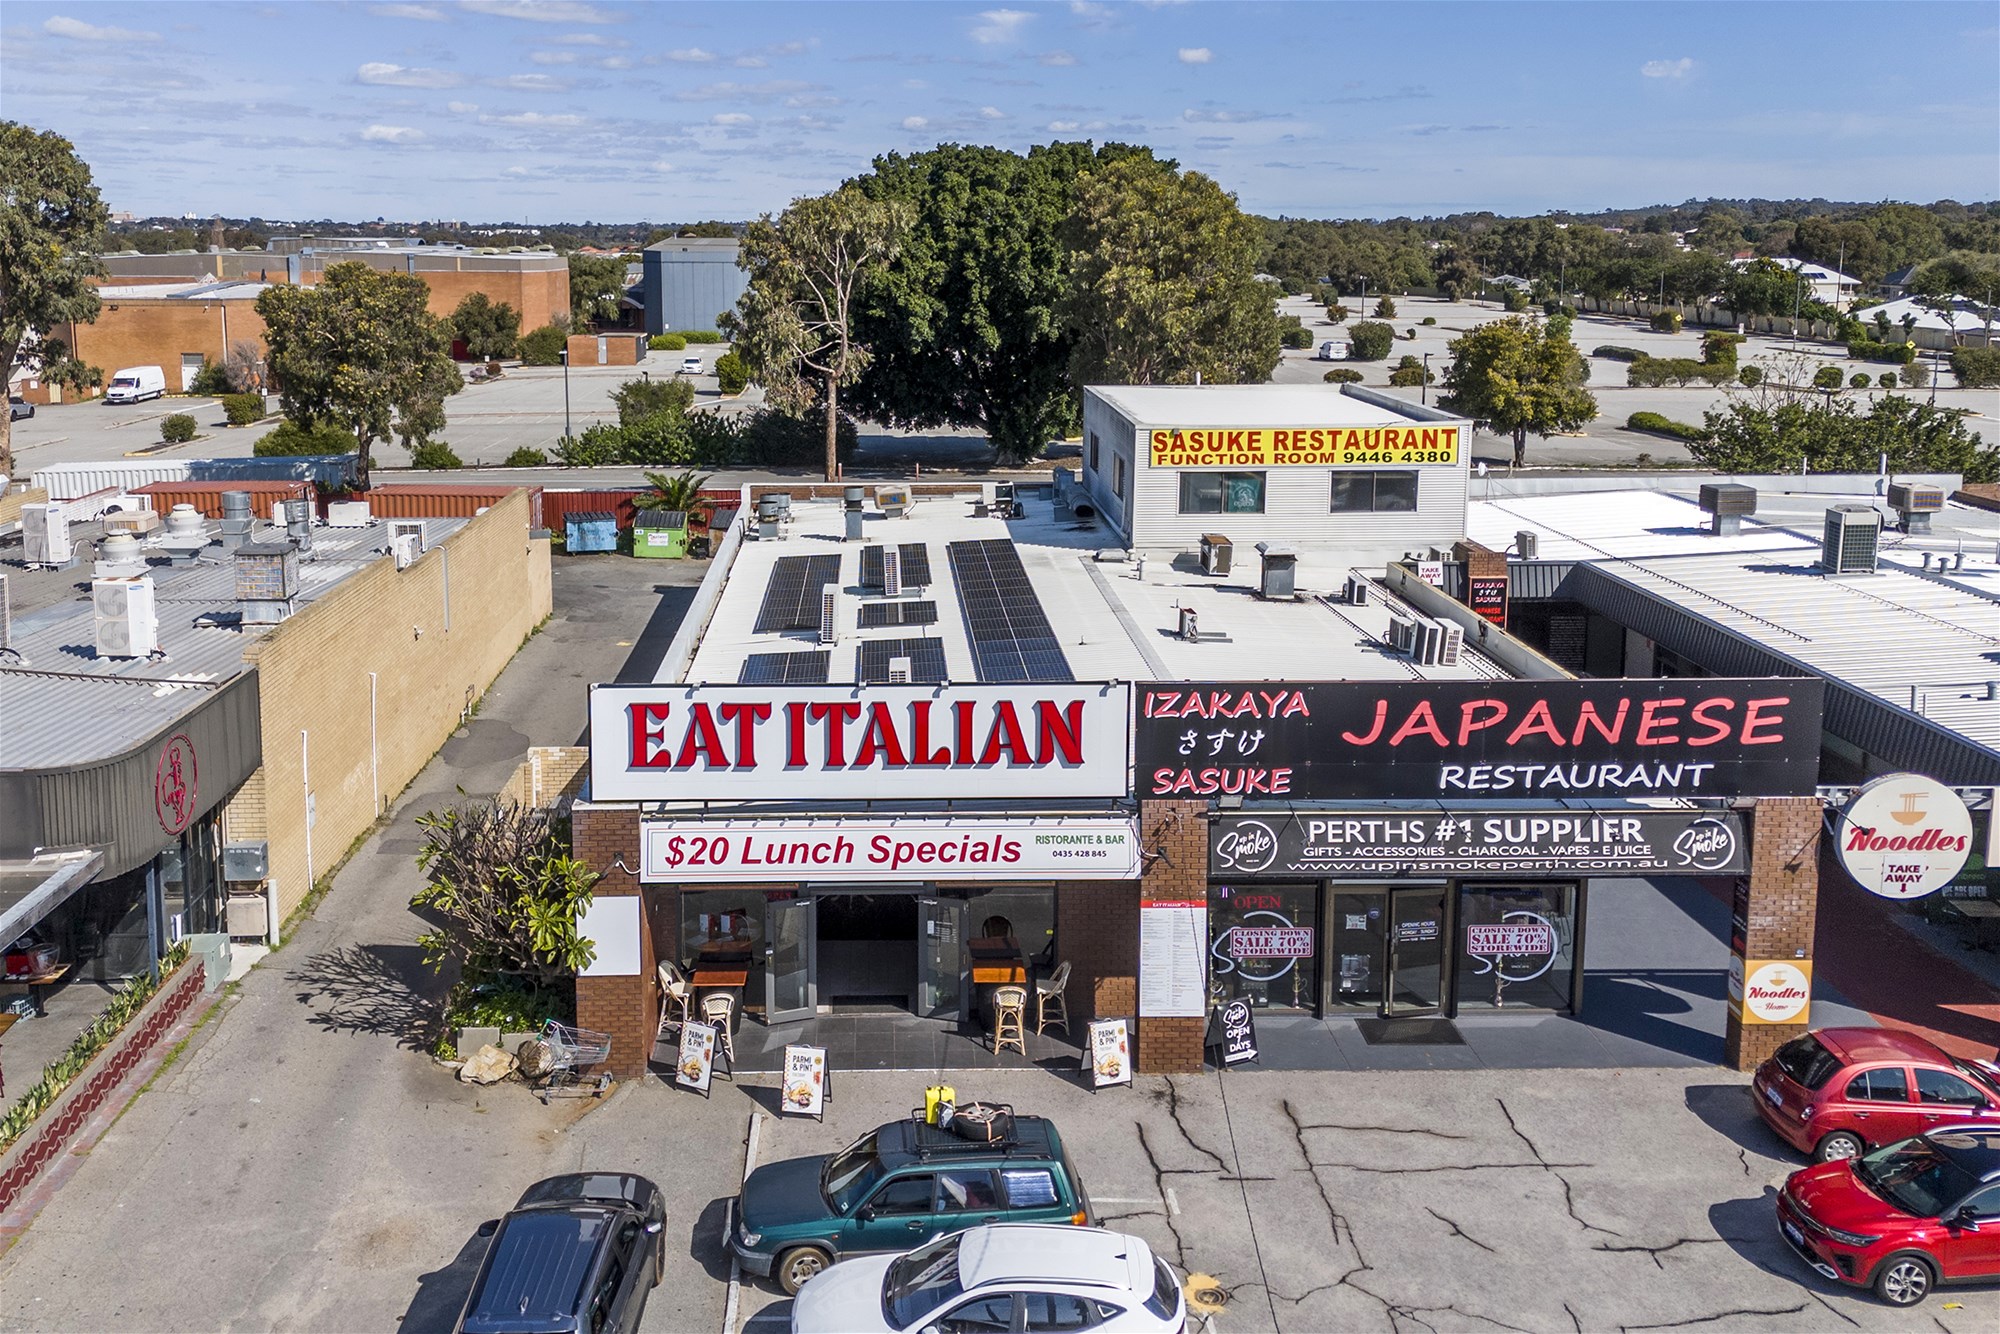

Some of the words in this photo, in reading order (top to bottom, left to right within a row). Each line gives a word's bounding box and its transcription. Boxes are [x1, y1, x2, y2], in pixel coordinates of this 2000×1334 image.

[1153, 431, 1261, 453] SASUKE
[1273, 429, 1457, 451] RESTAURANT
[1157, 453, 1265, 465] FUNCTION
[1274, 453, 1334, 464] ROOM
[1343, 451, 1393, 463] 9446
[1401, 451, 1450, 462] 4380
[1144, 690, 1310, 719] IZAKAYA
[1341, 697, 1790, 748] JAPANESE
[624, 702, 772, 773] EAT
[782, 700, 1086, 772] ITALIAN
[1179, 729, 1265, 756] さすけ
[1152, 768, 1293, 795] SASUKE
[1439, 763, 1714, 791] RESTAURANT
[1309, 820, 1425, 843] PERTHS
[1434, 819, 1473, 844] #1
[1483, 818, 1645, 844] SUPPLIER
[1035, 834, 1094, 845] RISTORANTE
[1096, 834, 1103, 844] &
[1105, 834, 1125, 844] BAR
[1845, 827, 1968, 852] Noodles
[665, 835, 729, 868] $20
[741, 836, 854, 865] Lunch
[868, 835, 1022, 870] Specials
[1303, 847, 1341, 857] GIFTS
[1355, 846, 1445, 857] ACCESSORIES
[1458, 846, 1539, 856] CHARCOAL
[1549, 846, 1590, 855] VAPES
[1613, 845, 1651, 856] JUICE
[1287, 858, 1668, 872] www.upinsmokeperth.com.au
[1888, 865, 1920, 873] TAKE
[1234, 895, 1281, 909] OPEN
[1234, 937, 1273, 947] SALE
[1278, 936, 1309, 947] 70%
[1472, 934, 1510, 943] SALE
[1516, 933, 1546, 943] 70%
[1234, 947, 1310, 955] STOREWIDE
[1748, 987, 1806, 999] Noodles
[1765, 1002, 1788, 1010] Home
[1226, 1026, 1250, 1038] OPEN
[693, 1039, 705, 1048] PINT
[1230, 1041, 1251, 1052] DAYS
[792, 1055, 811, 1063] PARMI
[799, 1063, 813, 1071] PINT
